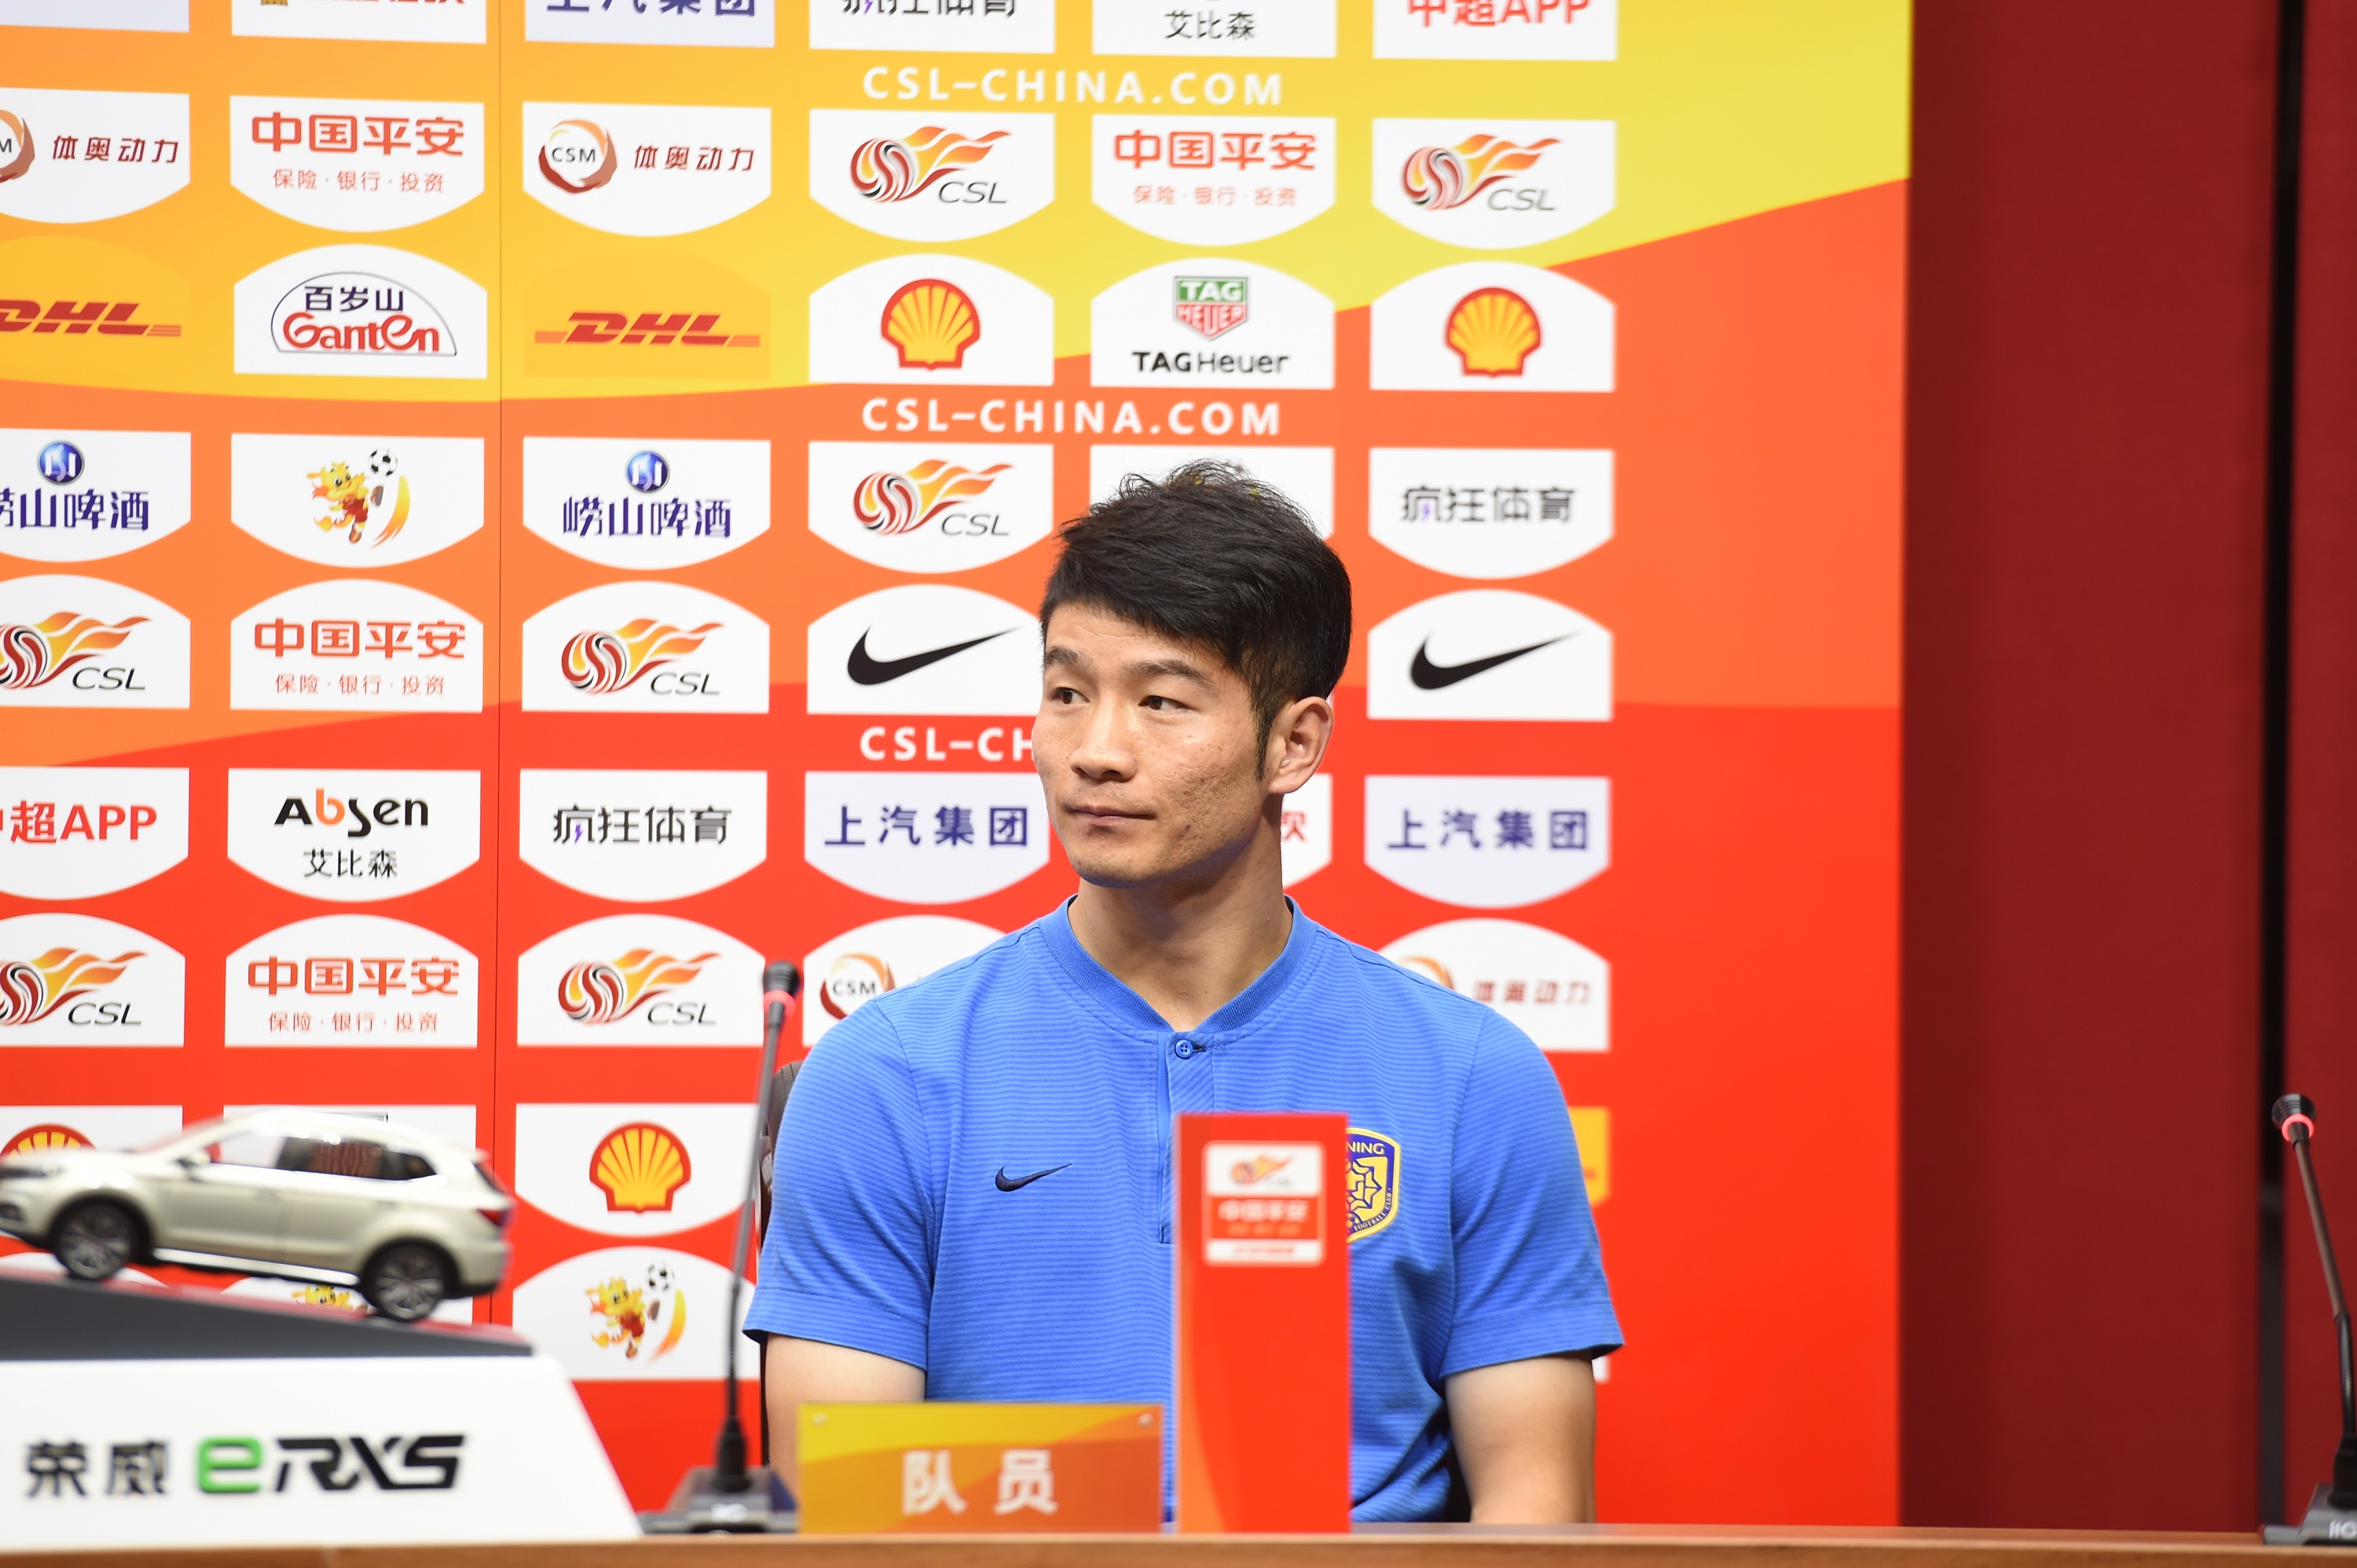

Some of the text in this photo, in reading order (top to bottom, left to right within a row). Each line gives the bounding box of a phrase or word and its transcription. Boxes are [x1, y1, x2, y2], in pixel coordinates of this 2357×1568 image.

[1164, 11, 1255, 40] 艾比森
[863, 66, 1282, 105] CSL-CHINA.COM
[52, 135, 178, 163] 体奥动力
[251, 112, 464, 156] 中国平安
[1114, 130, 1316, 170] 中国平安
[552, 147, 596, 163] CSM
[633, 145, 754, 171] 体奥动力
[937, 181, 1009, 204] CSL
[1486, 188, 1556, 211] CSL
[305, 285, 404, 313] 百岁山
[1180, 281, 1243, 302] TAG
[0, 299, 149, 335] DHL
[565, 311, 724, 346] DHL
[1177, 304, 1244, 335] HEUER
[862, 398, 1281, 436] CSL-CHINA.COM
[563, 496, 731, 538] 崂山啤酒
[1402, 485, 1577, 523] 疯狂体育
[941, 513, 1010, 537] CSL
[254, 617, 466, 660] 中国平安
[71, 667, 146, 691] CSL
[650, 672, 720, 696] CSL
[0, 800, 157, 844] 超APP
[274, 789, 429, 837] Absen
[553, 804, 732, 845] 疯狂体育
[824, 805, 1028, 846] 上汽集团
[1387, 809, 1589, 850] 上汽集团
[303, 848, 398, 878] 艾比森
[247, 955, 460, 996] 中国平安
[832, 980, 876, 995] CSM
[68, 1002, 142, 1026] CSL
[647, 1002, 717, 1026] CSL
[1353, 1192, 1393, 1232] FOOTBALL CLUB
[26, 1439, 167, 1497] 荣威
[902, 1449, 1059, 1515] 队员
